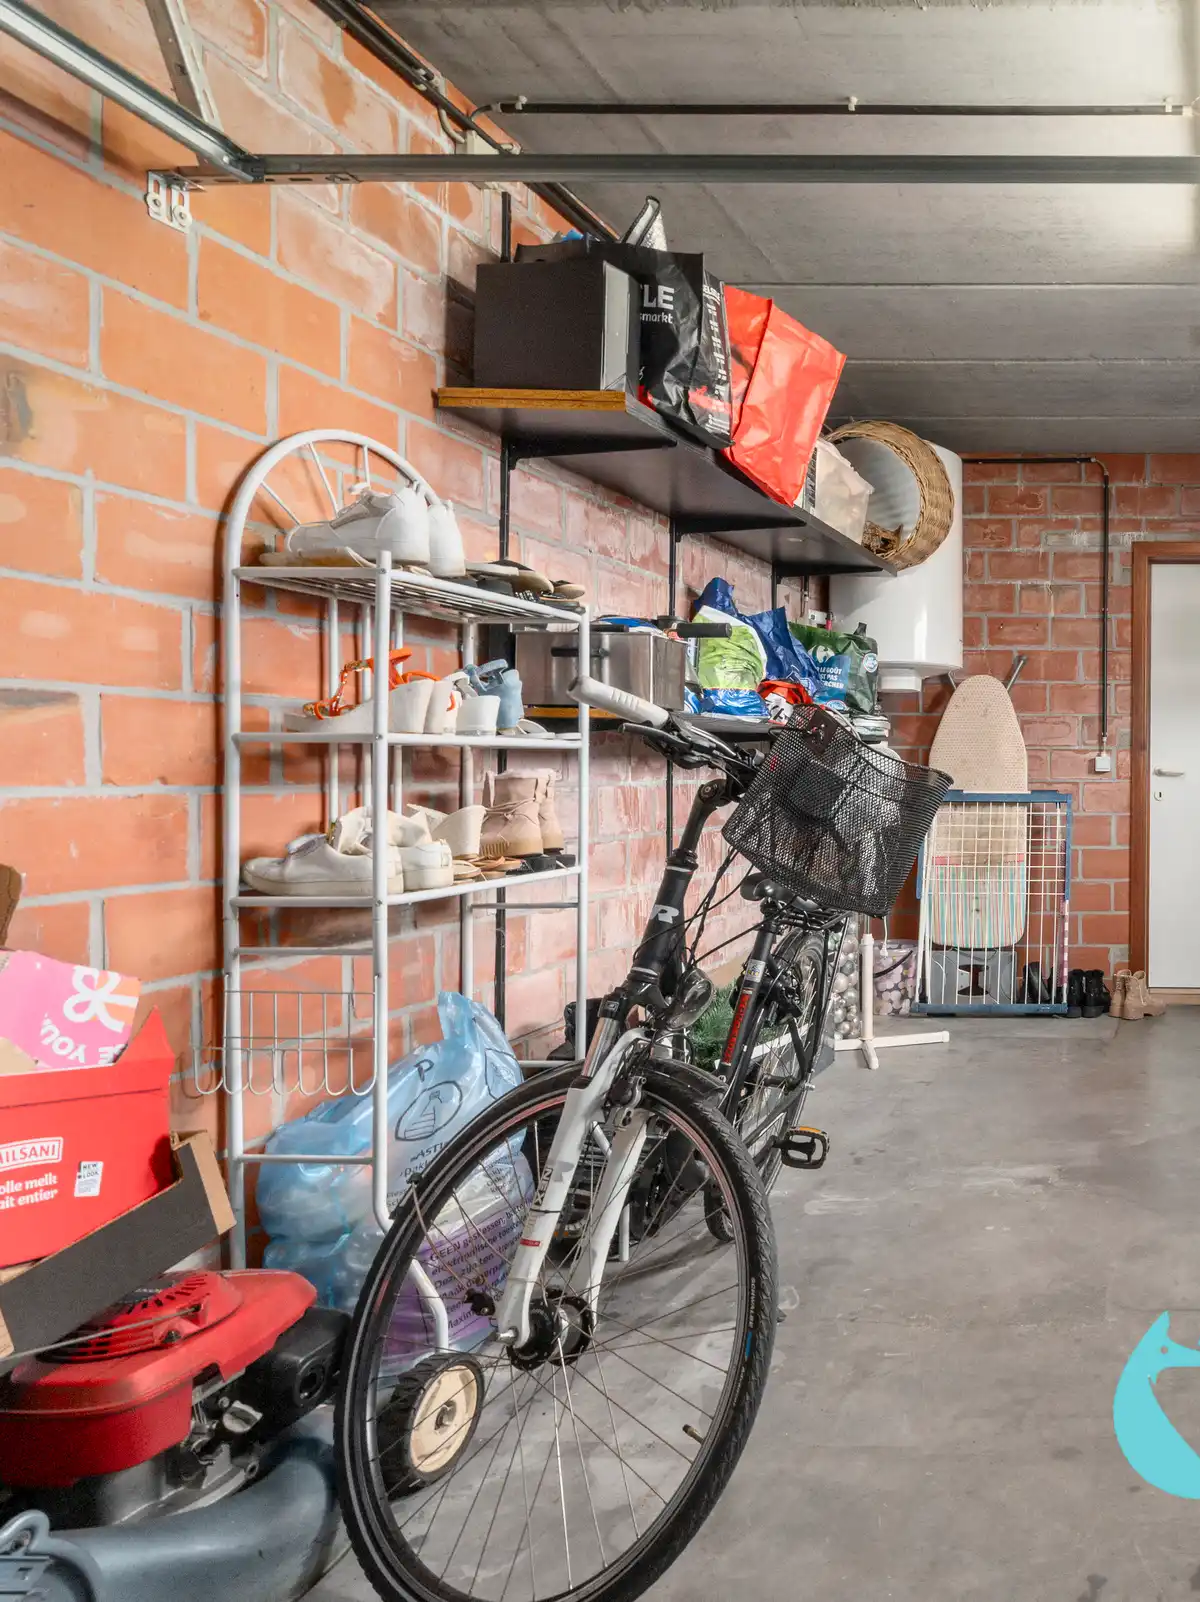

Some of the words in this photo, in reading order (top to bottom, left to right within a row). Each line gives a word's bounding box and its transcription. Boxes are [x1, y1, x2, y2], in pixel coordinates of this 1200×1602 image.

[640, 284, 675, 311] LE
[24, 1172, 58, 1191] melk
[17, 1189, 59, 1206] entier
